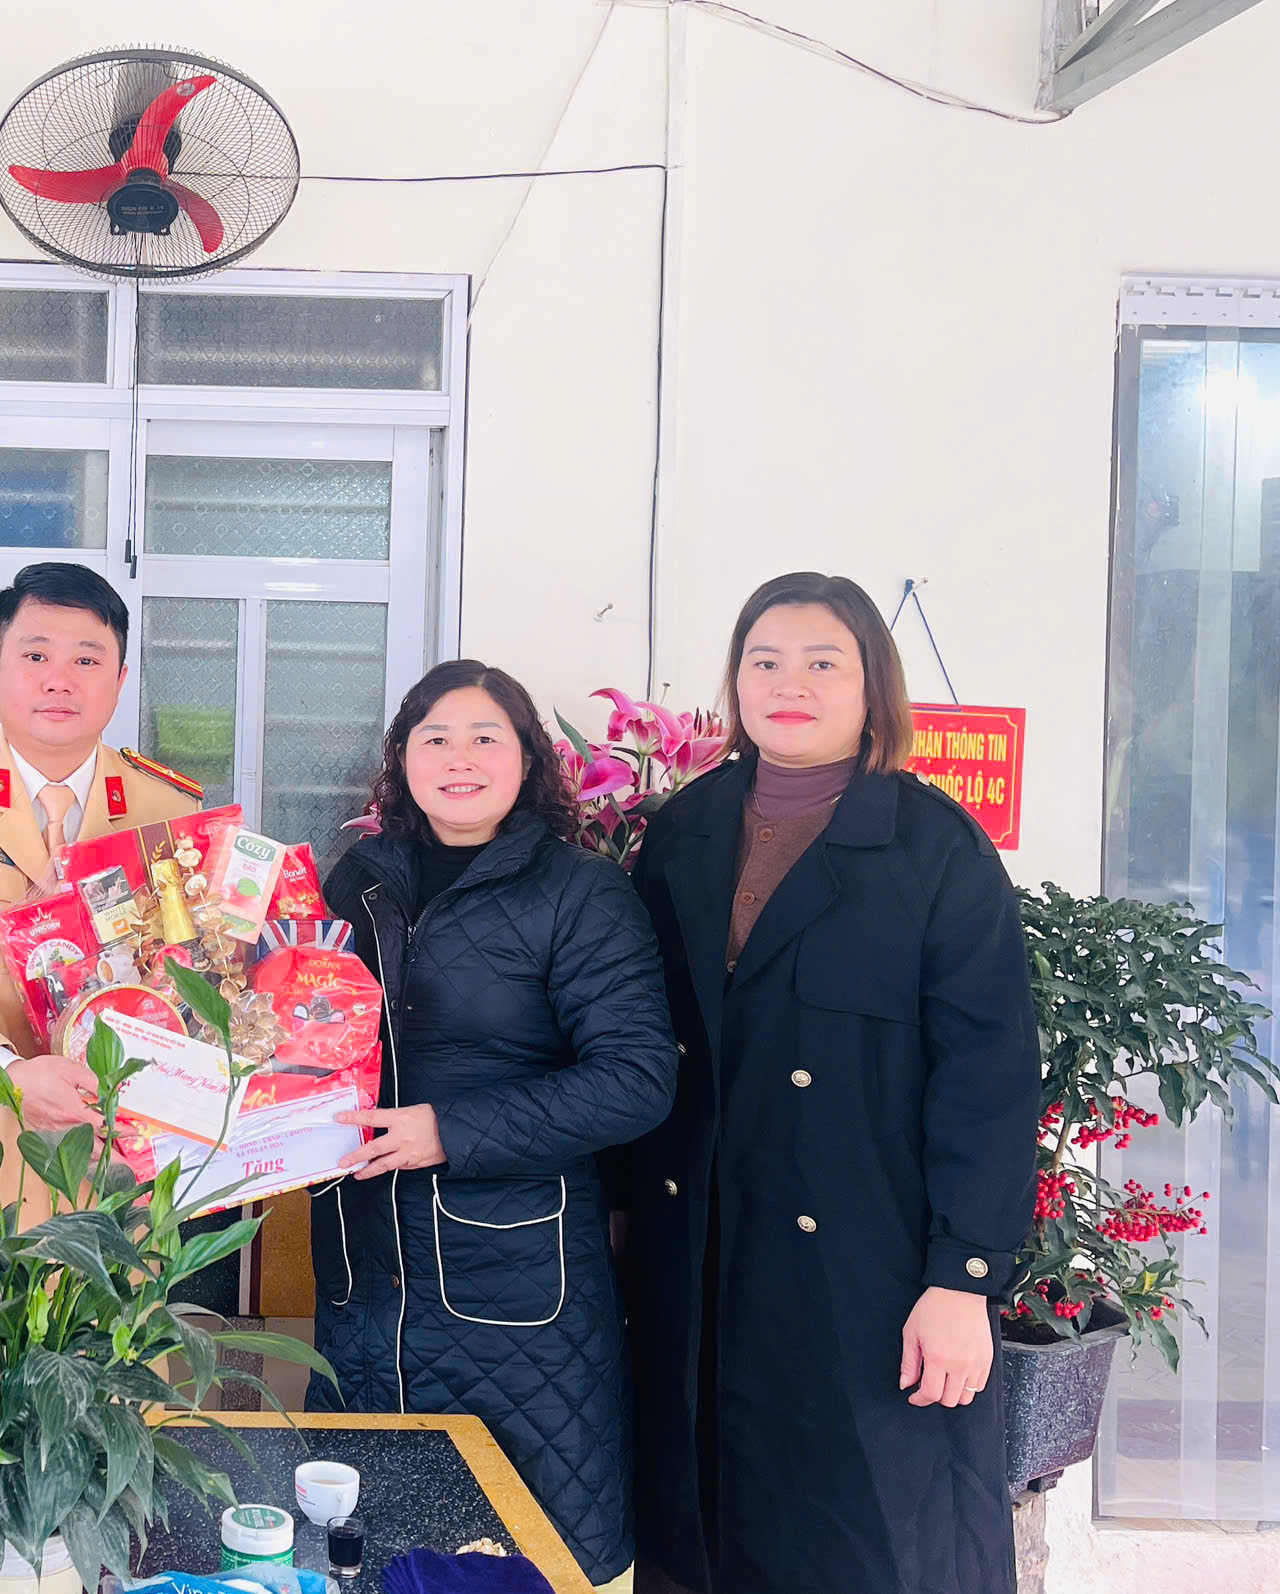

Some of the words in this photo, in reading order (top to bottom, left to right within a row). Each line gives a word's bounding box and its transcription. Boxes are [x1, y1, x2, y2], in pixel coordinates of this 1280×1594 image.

[946, 727, 984, 761] THÔNG
[988, 734, 1008, 762] TIN
[987, 777, 1006, 805] 4C
[236, 837, 271, 860] Cozy
[29, 921, 61, 937] UNICORN
